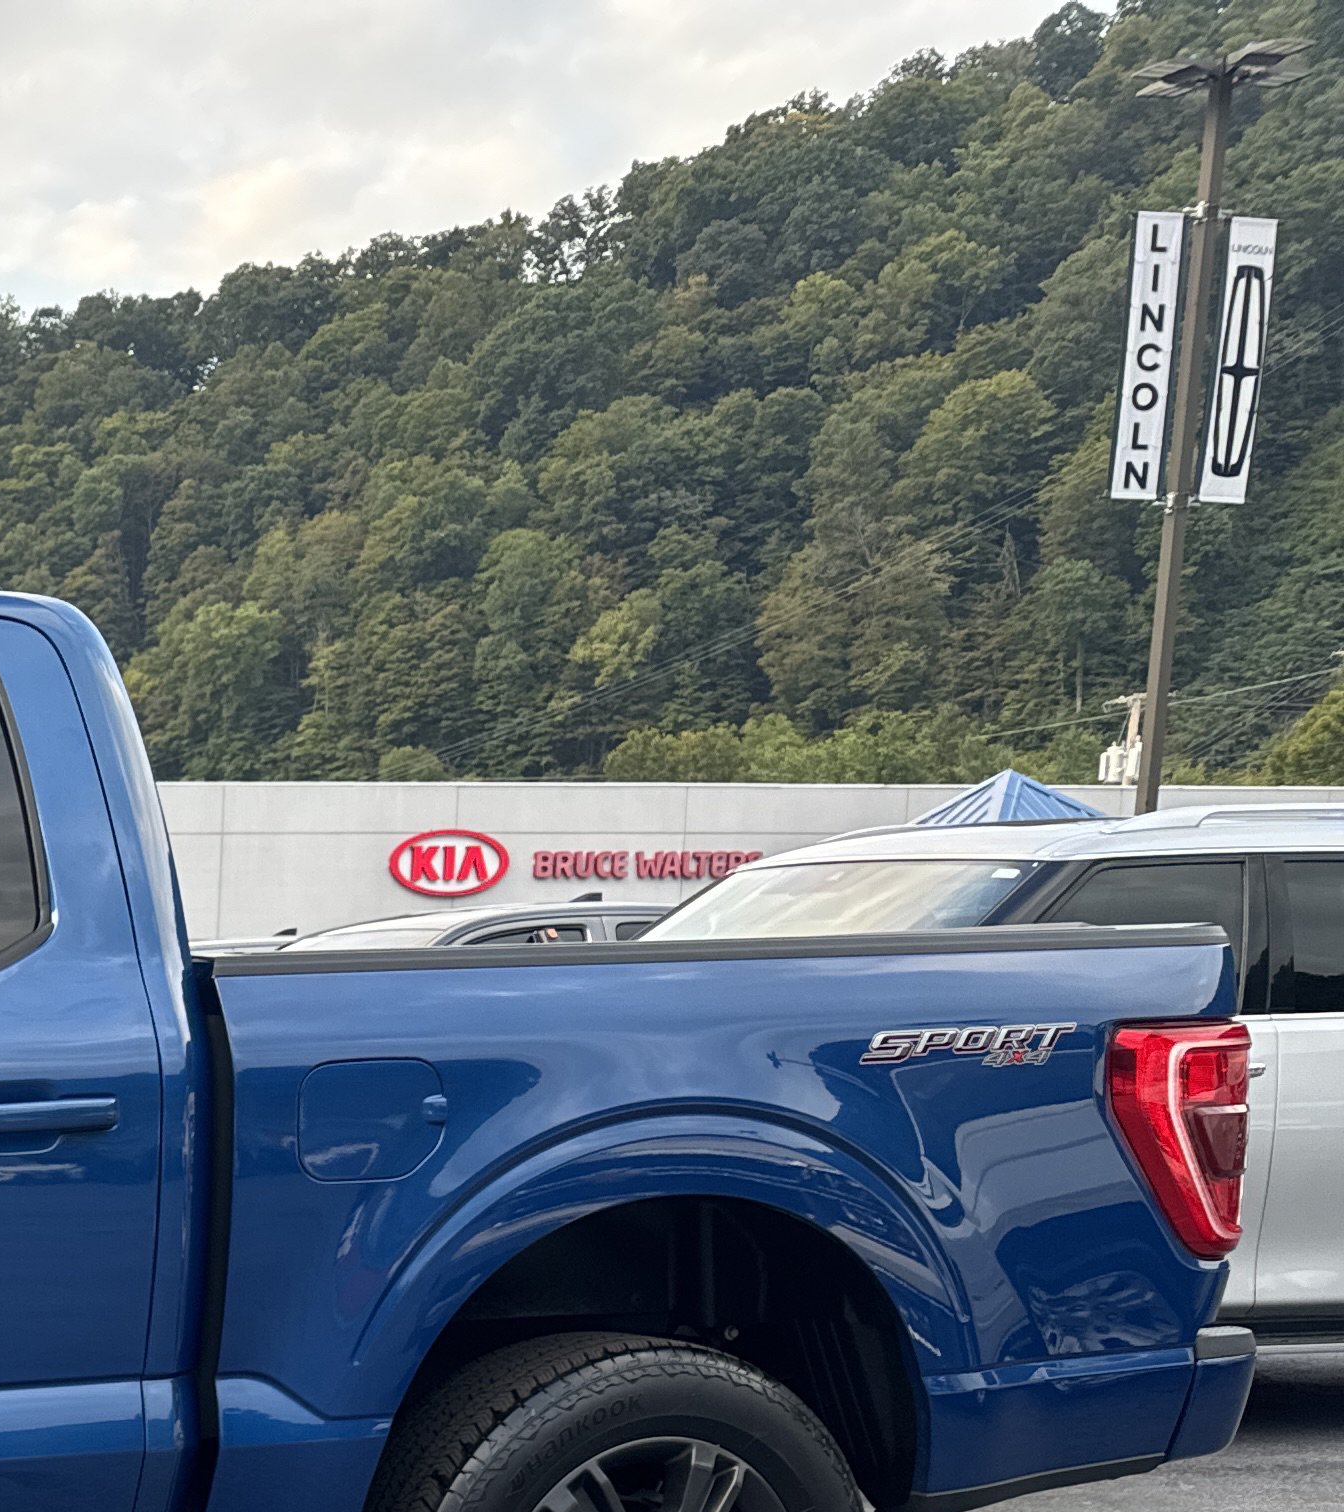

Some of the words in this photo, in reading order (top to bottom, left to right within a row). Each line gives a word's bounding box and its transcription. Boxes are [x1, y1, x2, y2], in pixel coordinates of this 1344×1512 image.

[1123, 223, 1167, 491] LINCOLN
[410, 845, 489, 882] KIA
[532, 851, 629, 880] BRUCE
[859, 1021, 1078, 1065] SPORT
